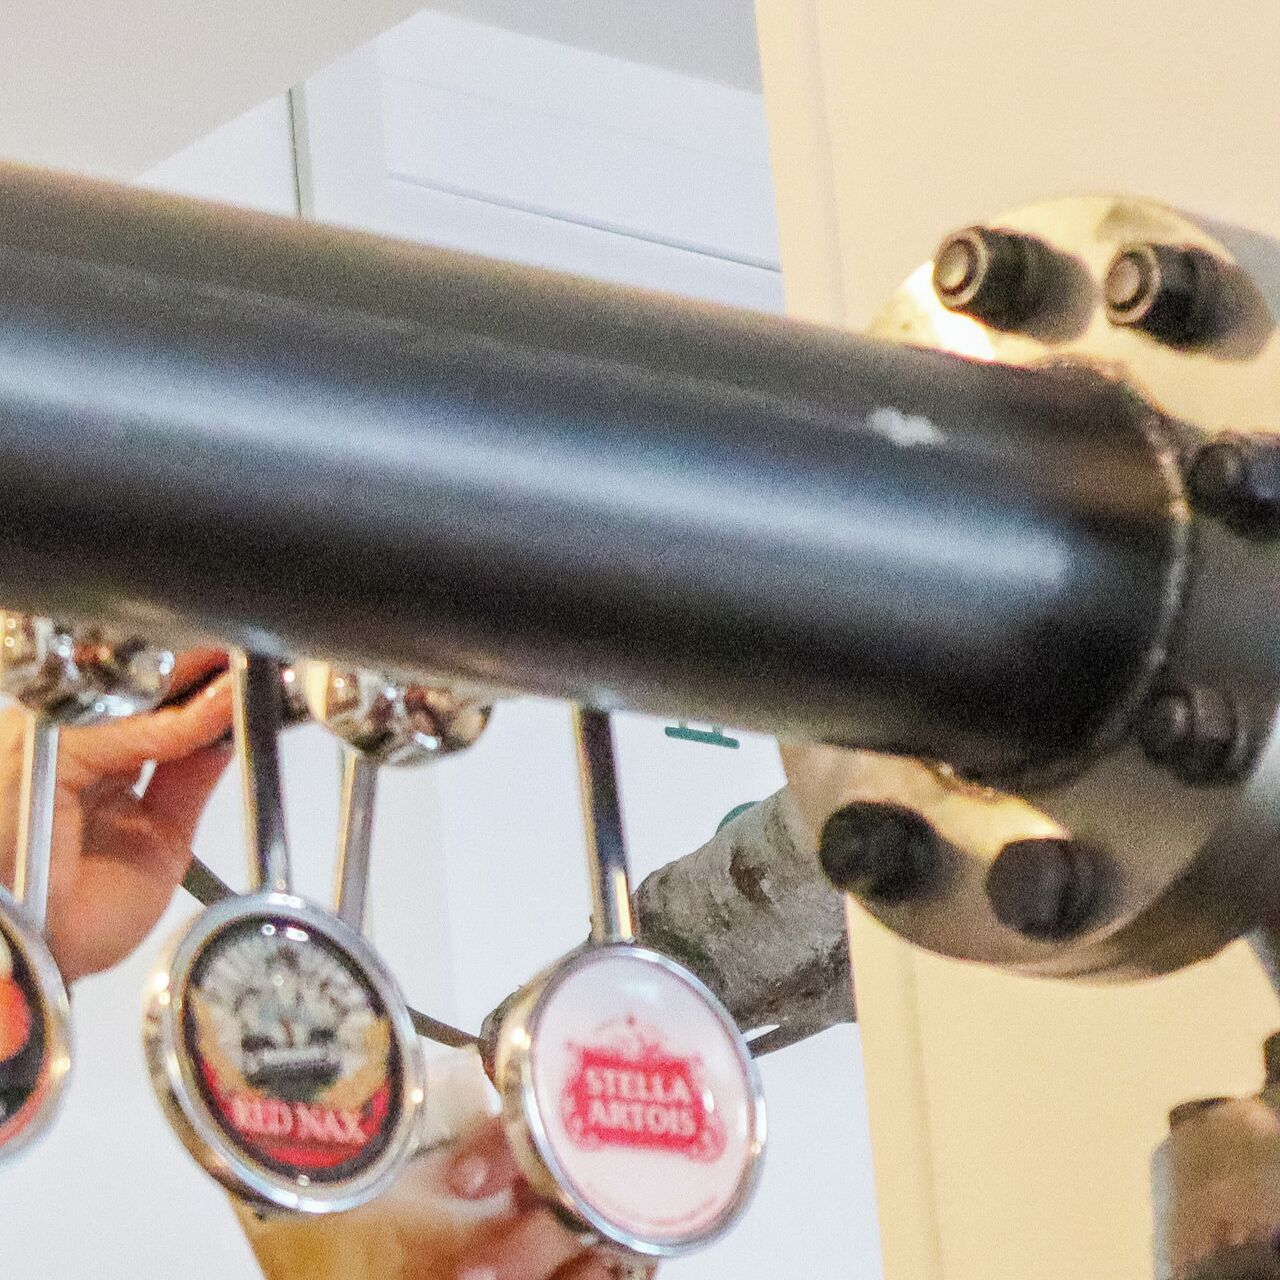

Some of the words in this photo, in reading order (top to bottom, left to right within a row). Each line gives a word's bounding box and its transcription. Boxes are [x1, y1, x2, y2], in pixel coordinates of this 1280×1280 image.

[585, 1068, 692, 1103] STELLA
[231, 1097, 293, 1136] RED
[588, 1100, 697, 1136] ARTOIS
